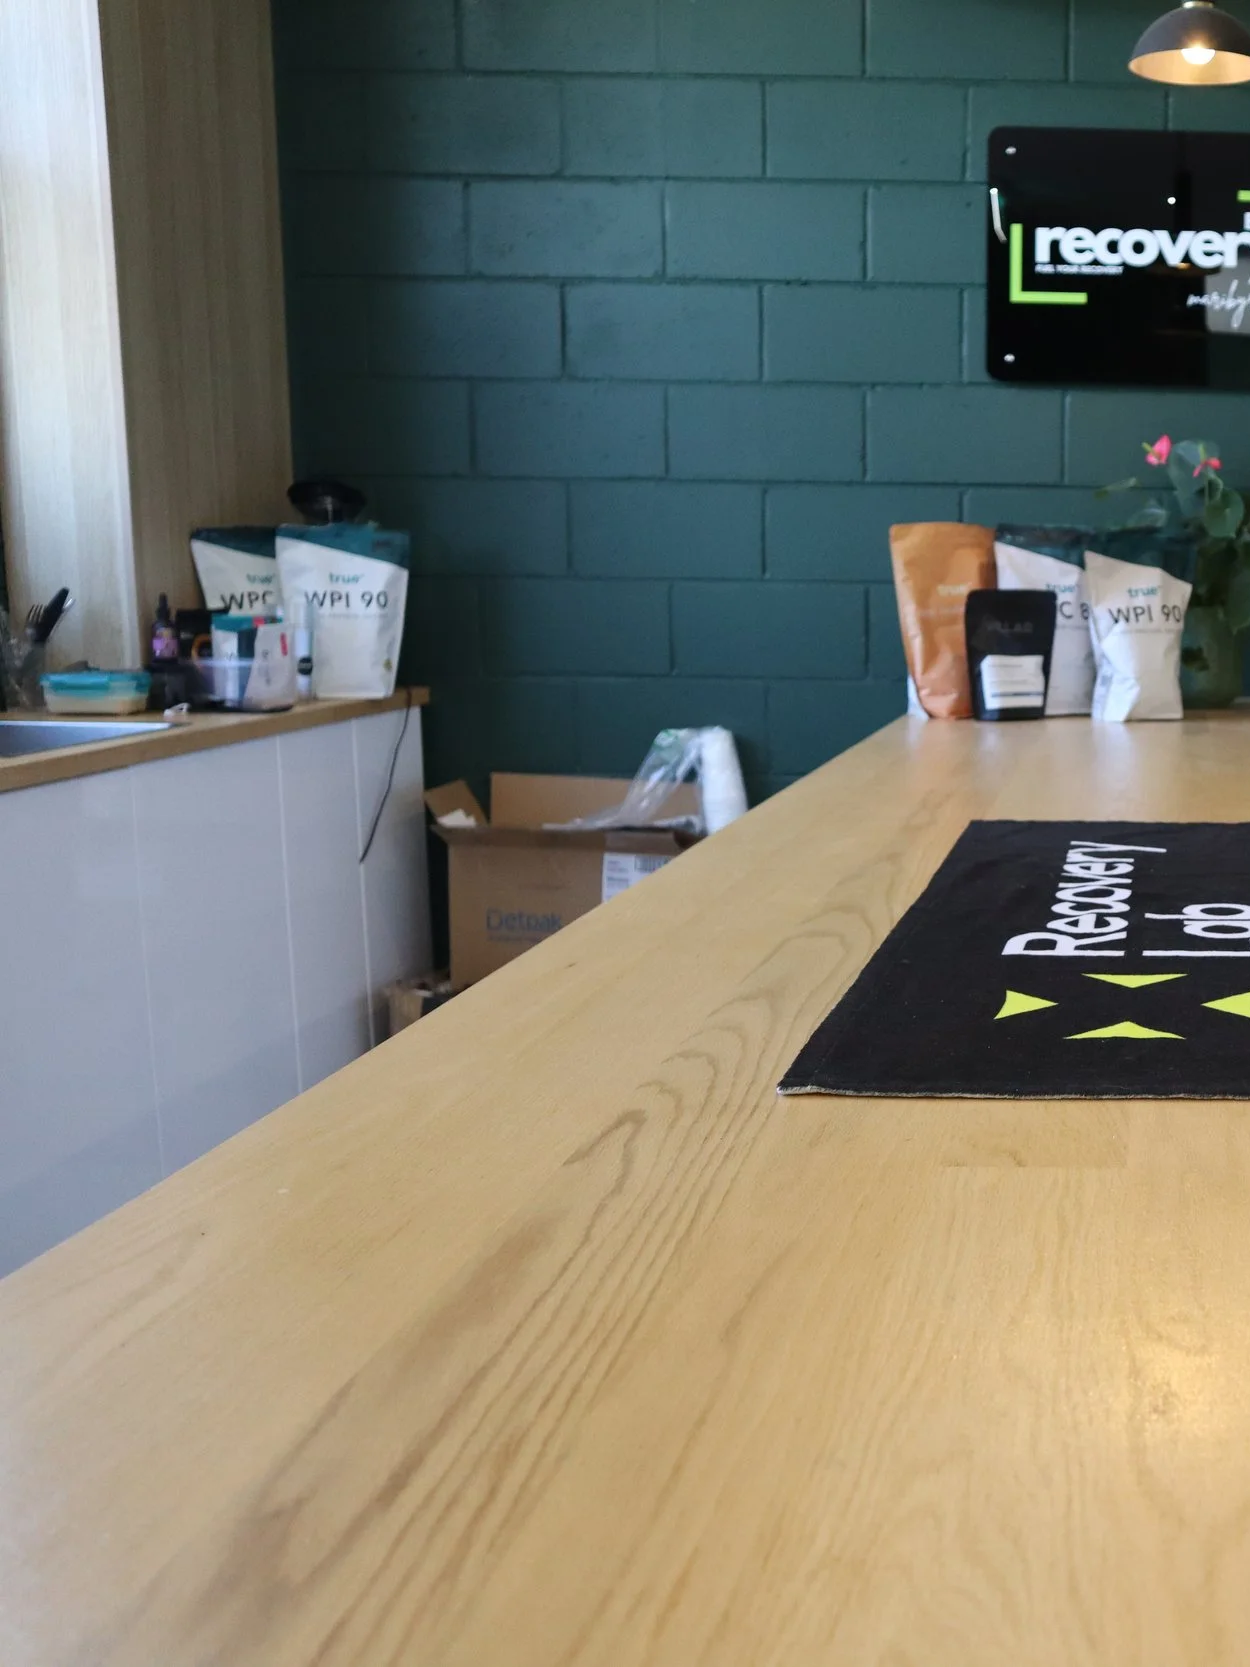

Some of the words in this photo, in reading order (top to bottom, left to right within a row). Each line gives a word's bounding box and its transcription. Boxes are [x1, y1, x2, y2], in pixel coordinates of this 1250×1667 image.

[329, 572, 360, 585] true
[305, 590, 351, 608] WPI
[361, 591, 389, 608] 90
[1127, 587, 1158, 597] true
[1108, 604, 1153, 624] WPI
[1161, 604, 1181, 622] 90
[1002, 841, 1166, 956] Recovery
